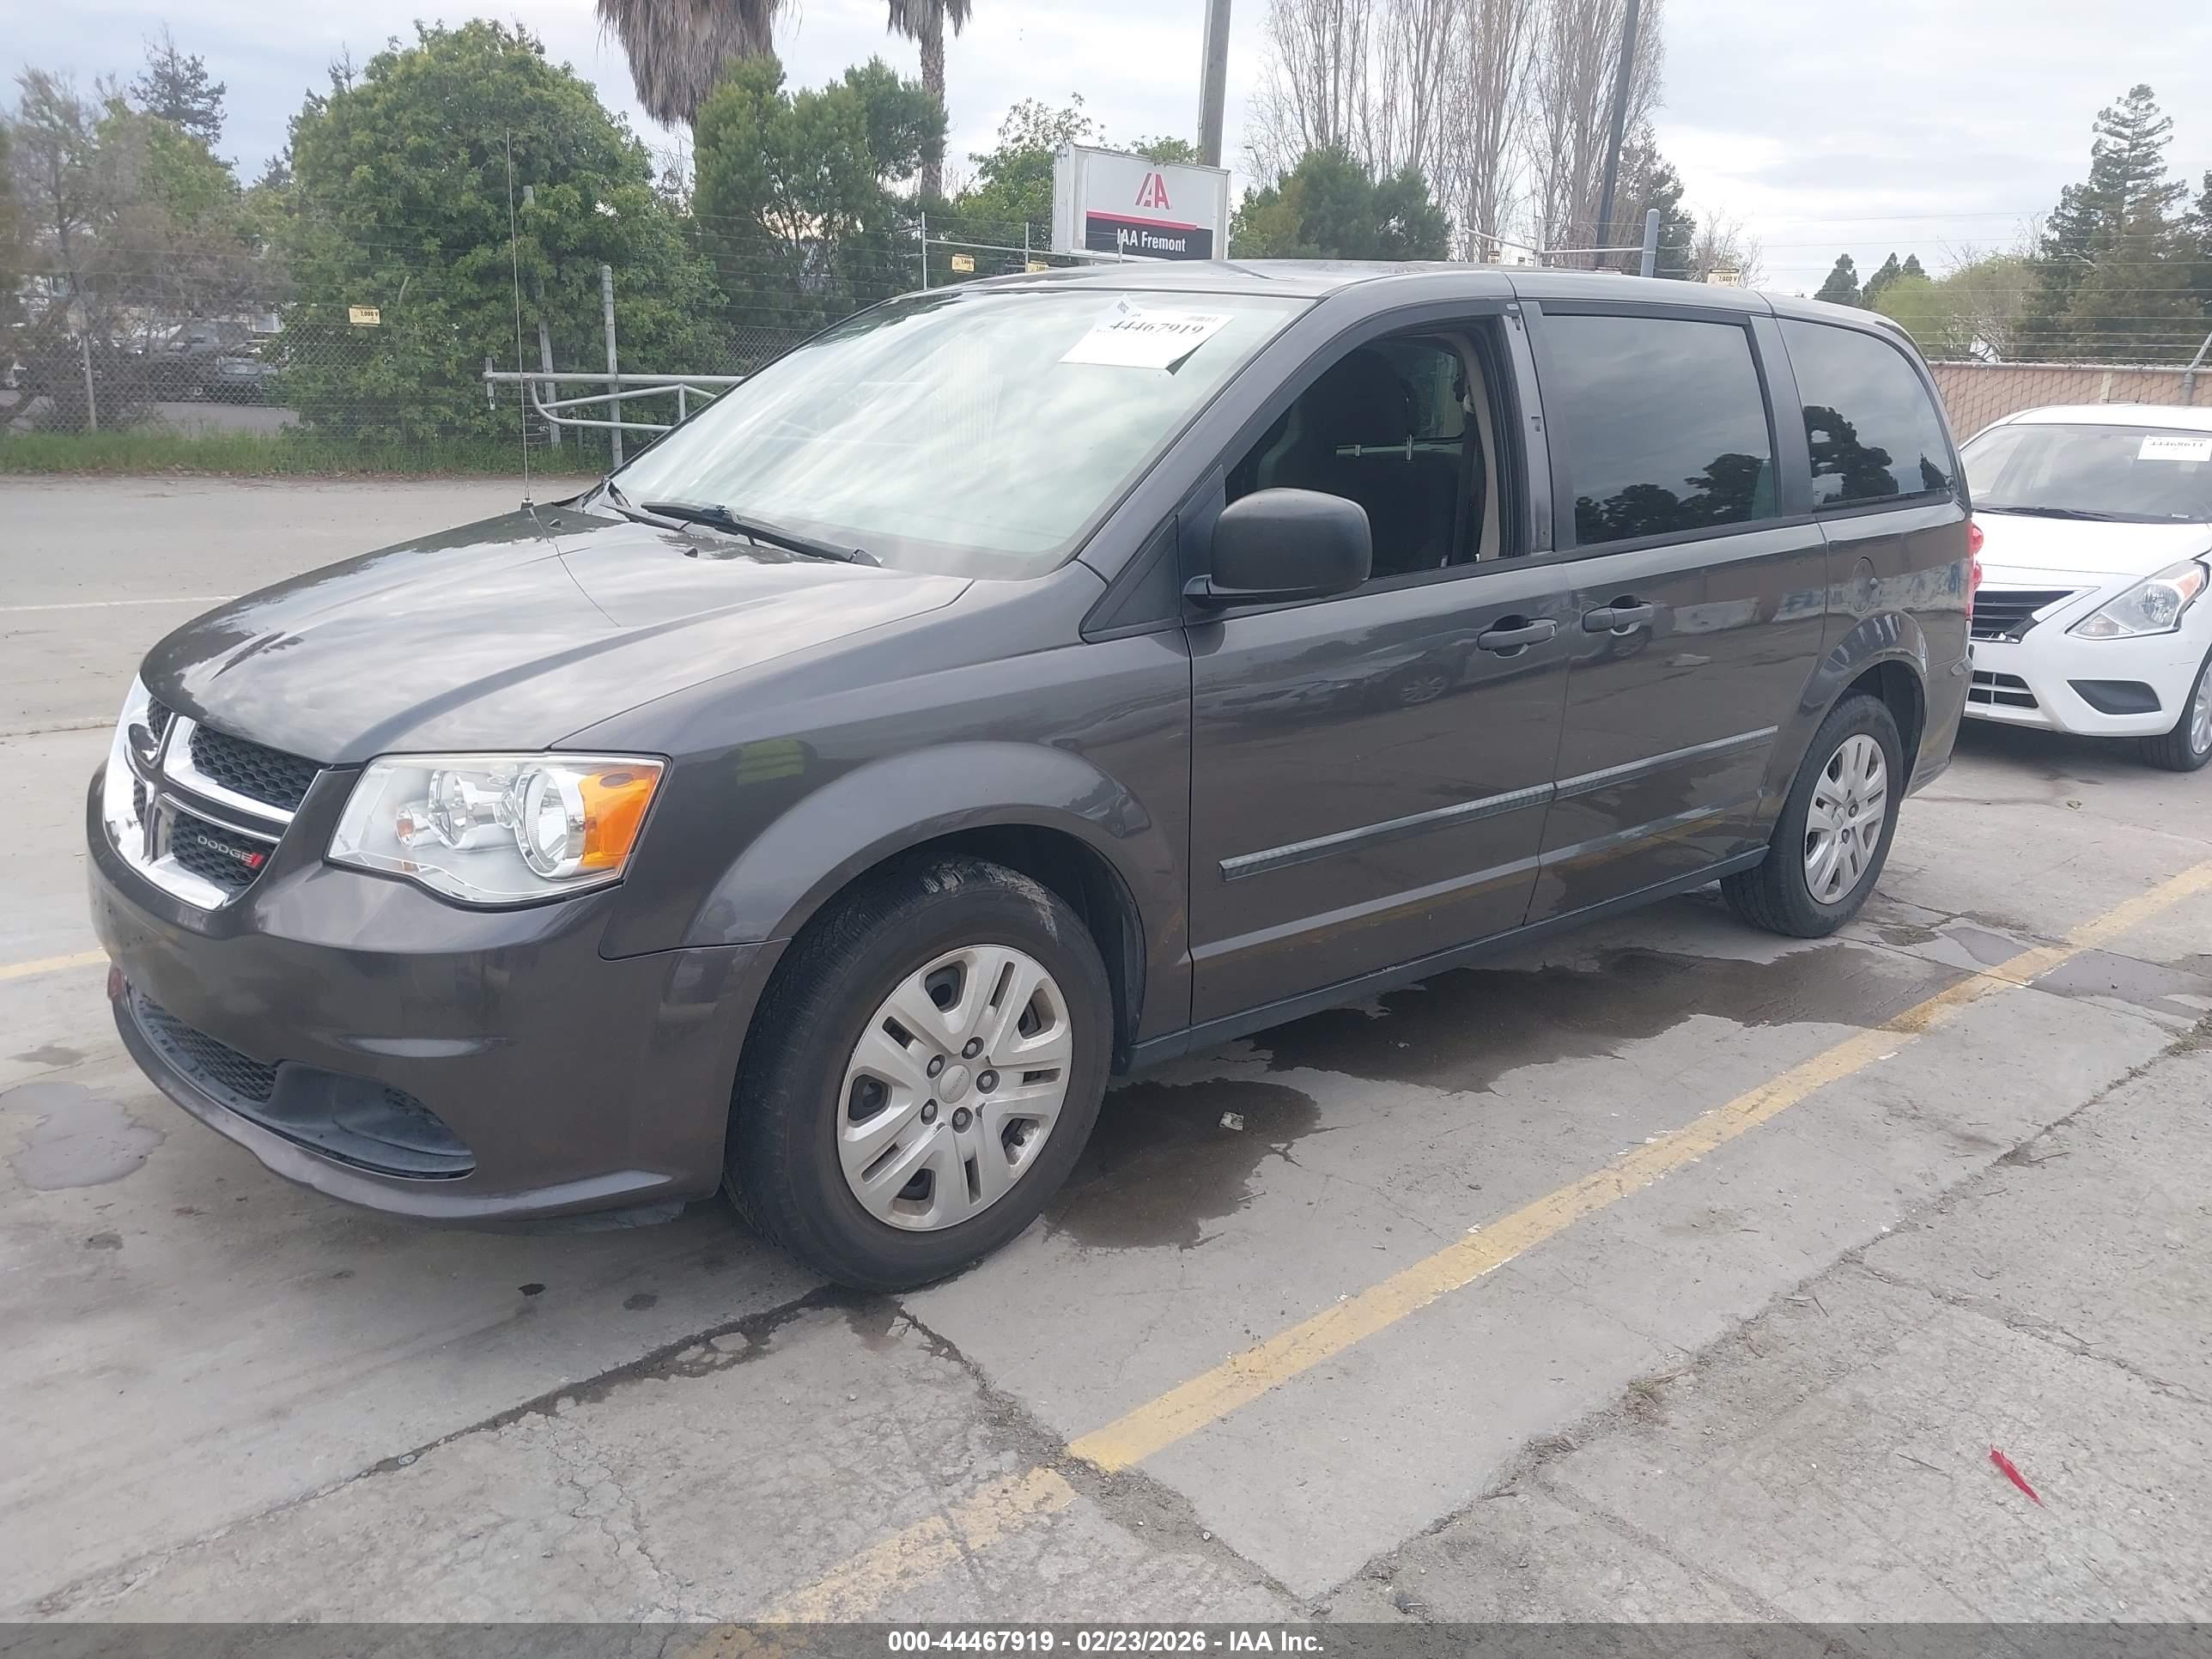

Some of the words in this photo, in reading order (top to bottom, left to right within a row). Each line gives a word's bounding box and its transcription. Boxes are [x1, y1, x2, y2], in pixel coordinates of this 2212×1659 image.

[1117, 228, 1138, 246] IAA
[1141, 231, 1186, 252] Fremont
[1109, 320, 1205, 335] 44467919
[198, 835, 253, 864] DODGE
